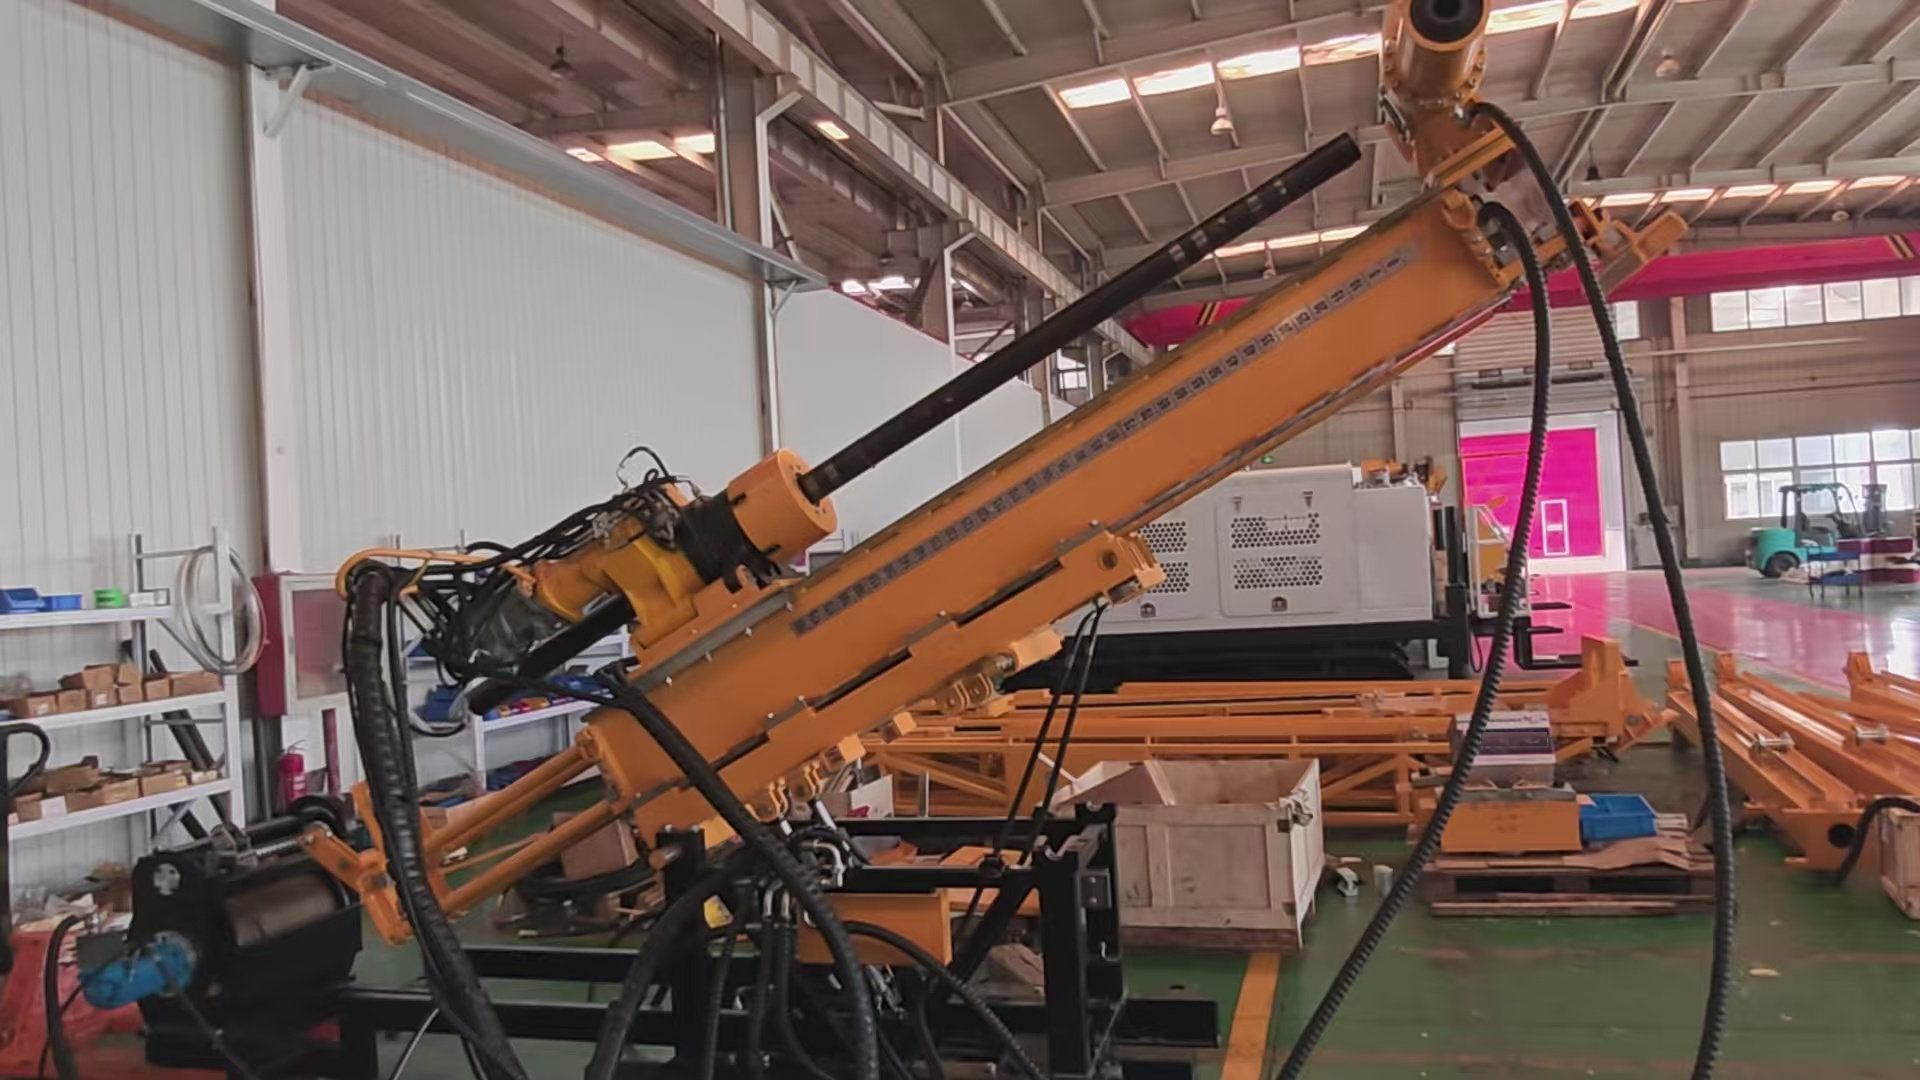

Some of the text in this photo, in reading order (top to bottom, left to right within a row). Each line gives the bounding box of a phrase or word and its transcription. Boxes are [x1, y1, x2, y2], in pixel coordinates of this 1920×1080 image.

[1348, 277, 1363, 292] 10
[1330, 288, 1346, 303] 15
[1312, 299, 1328, 314] 20
[1294, 310, 1311, 325] 25
[1259, 332, 1275, 347] 35
[1241, 343, 1257, 358] 40
[1224, 354, 1240, 369] 45
[1207, 365, 1222, 379] 50
[1190, 375, 1205, 389] 55
[1173, 386, 1188, 400] 60
[1156, 397, 1171, 411] 65
[1139, 407, 1154, 421] 70
[1122, 417, 1138, 431] 75
